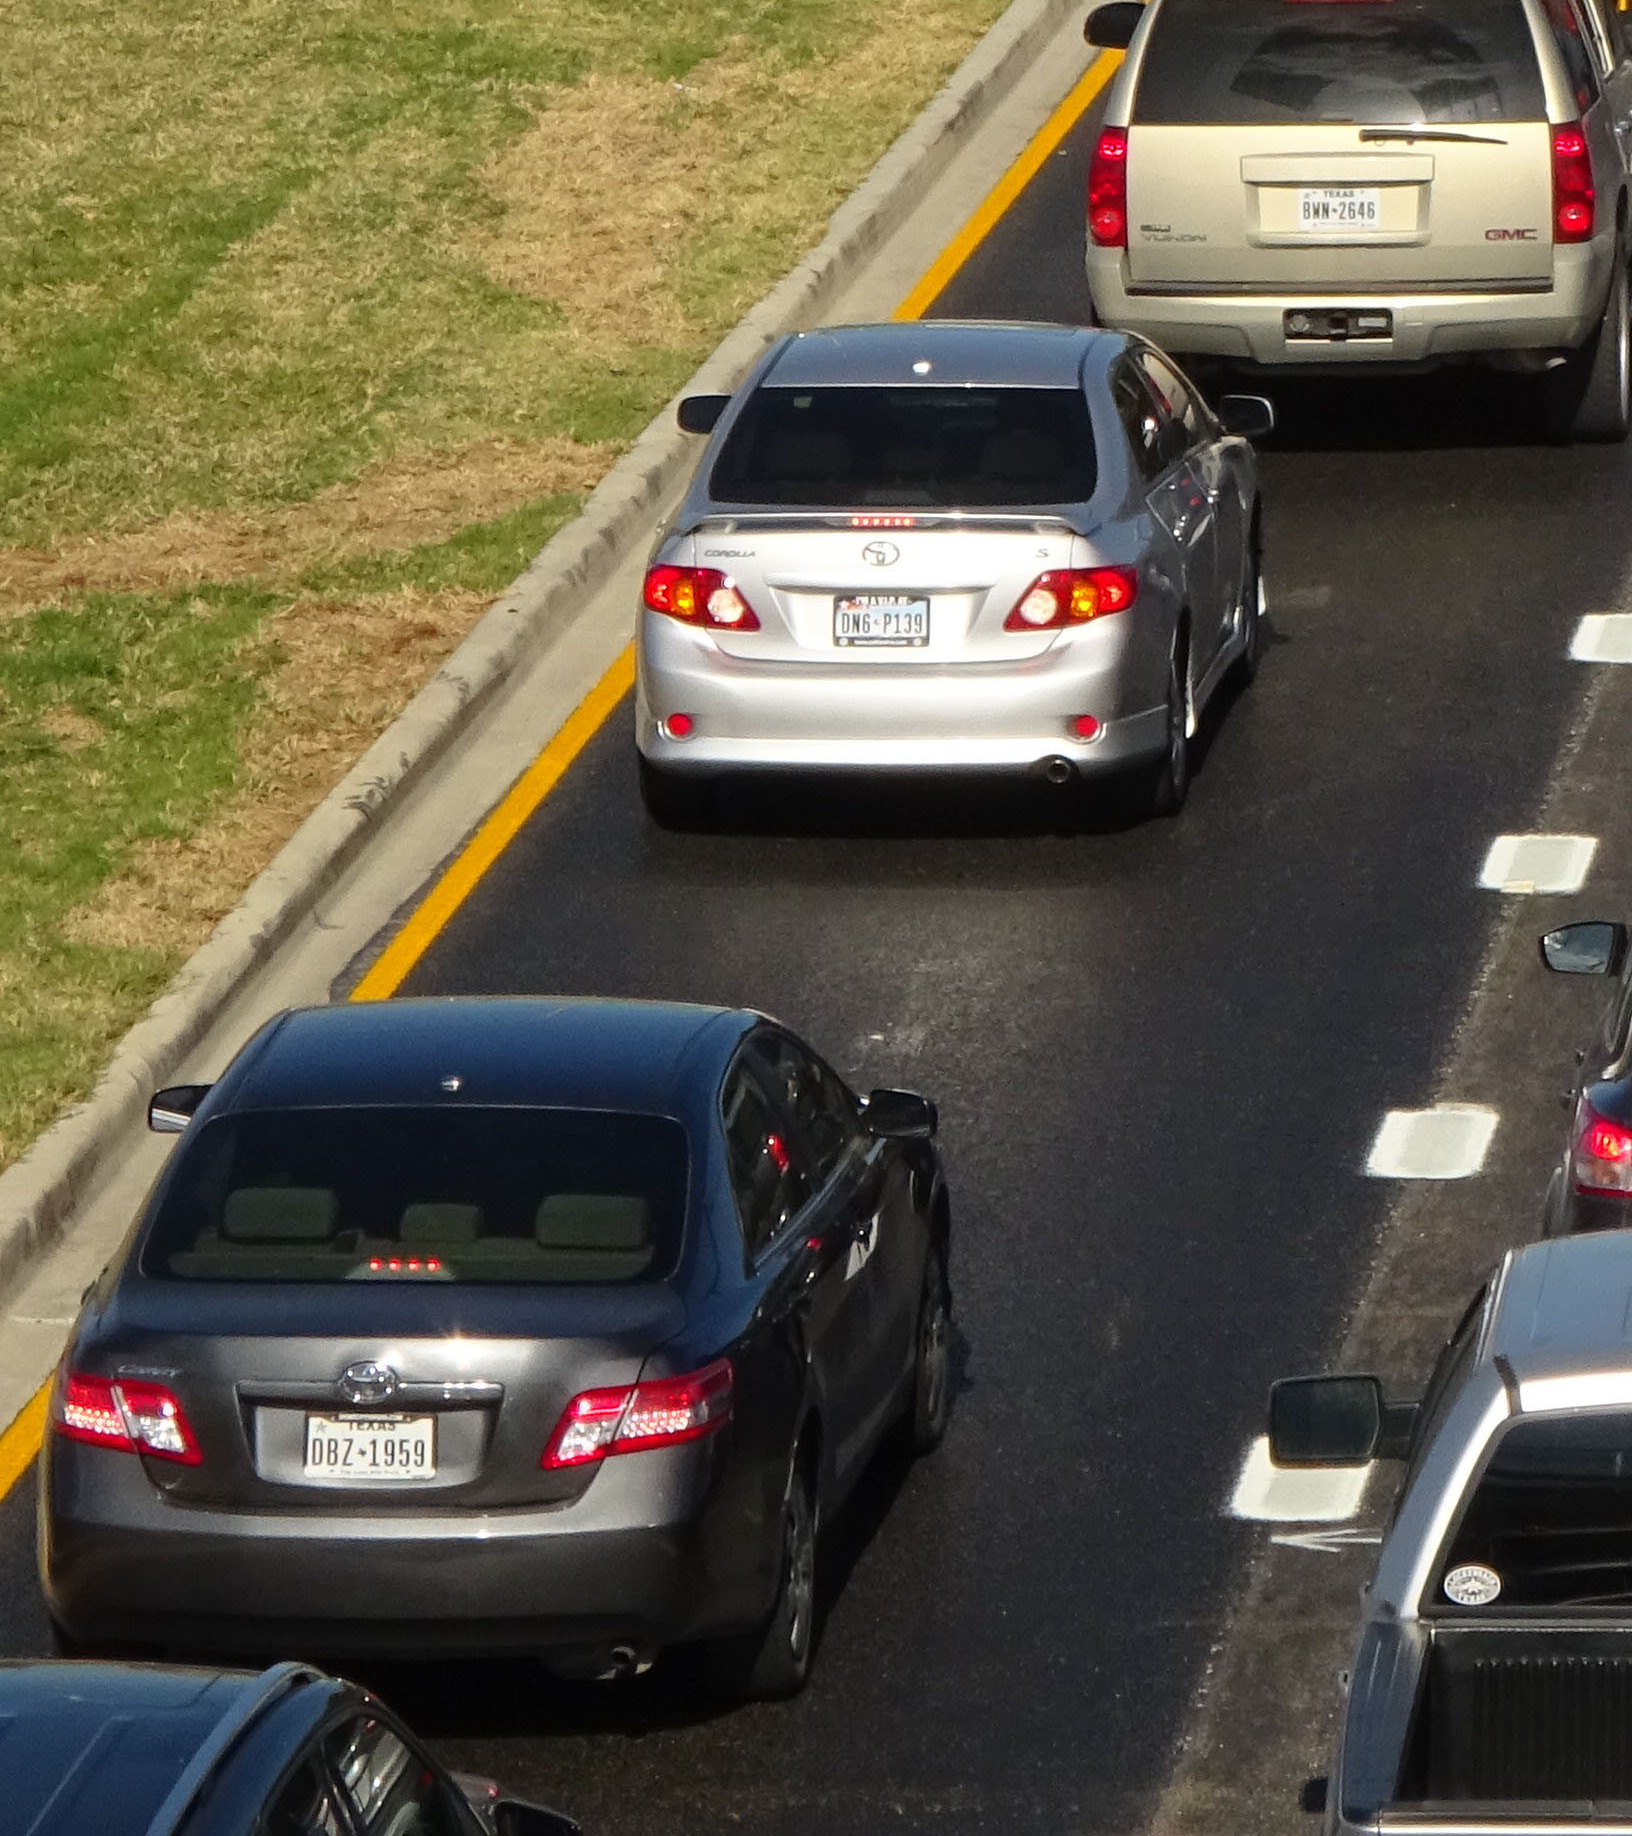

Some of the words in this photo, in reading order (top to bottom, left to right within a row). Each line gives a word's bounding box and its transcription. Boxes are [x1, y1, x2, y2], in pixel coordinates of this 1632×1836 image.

[1324, 191, 1355, 199] TEXAS
[1484, 228, 1538, 241] GMC
[704, 549, 755, 557] COROLLA
[348, 1421, 397, 1432] TEXAS
